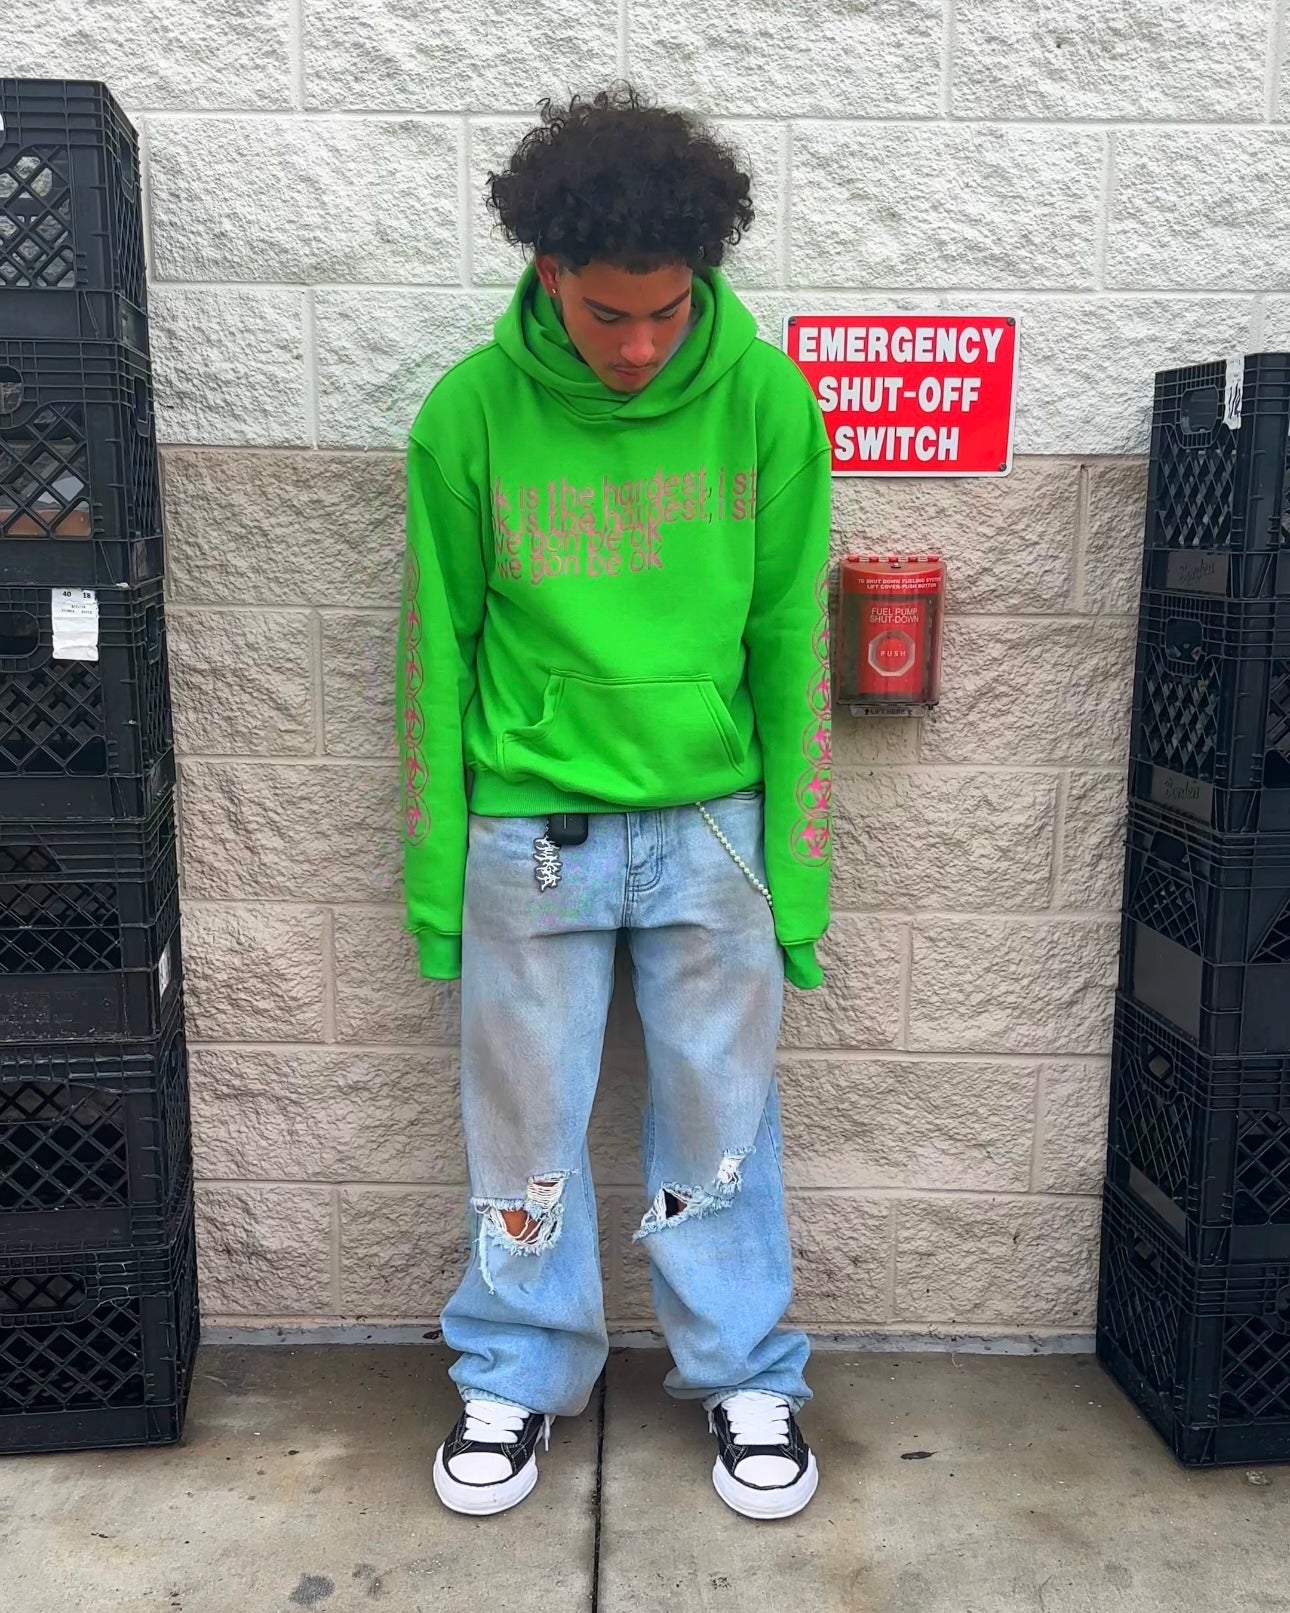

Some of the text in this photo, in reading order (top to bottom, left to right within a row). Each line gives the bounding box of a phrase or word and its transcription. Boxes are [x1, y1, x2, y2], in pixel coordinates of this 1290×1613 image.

[799, 326, 1004, 363] EMERGENCY
[818, 376, 982, 413] SHUT-OFF
[834, 425, 960, 462] SWITCH
[548, 476, 595, 509] the
[531, 553, 580, 586] gon
[588, 545, 622, 577] be
[631, 542, 663, 573] ok
[870, 615, 919, 624] SHUT-DOWN
[871, 607, 918, 616] FUEL PUMP
